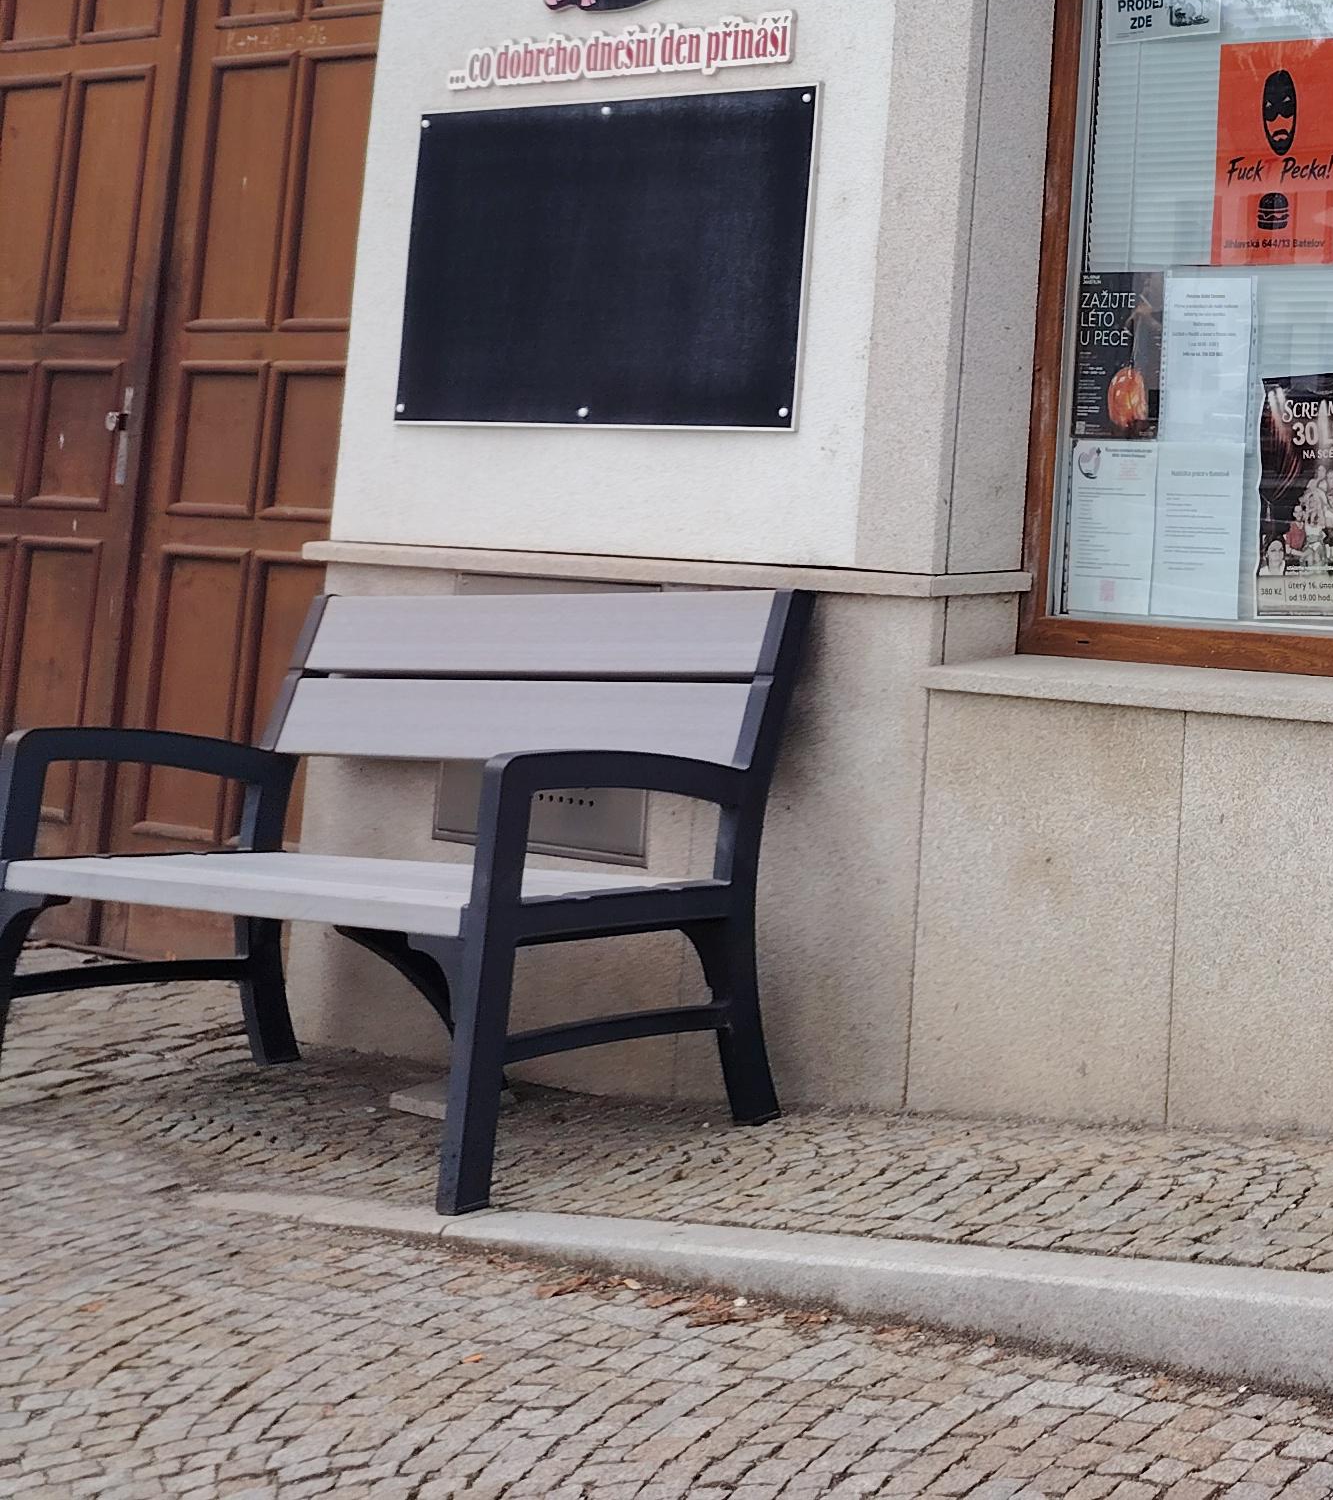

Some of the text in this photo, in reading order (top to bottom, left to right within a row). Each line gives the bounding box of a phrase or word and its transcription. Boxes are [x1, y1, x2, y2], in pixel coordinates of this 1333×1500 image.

[1129, 15, 1153, 30] ZDE
[499, 35, 581, 80] dobrého
[585, 27, 656, 74] dnešní
[660, 28, 702, 67] den
[706, 16, 791, 70] přináší
[1292, 238, 1325, 249] Batelov
[1081, 289, 1137, 309] ZAŽIJTE
[1080, 308, 1115, 328] LÉTO
[1079, 330, 1090, 346] U
[1291, 421, 1318, 446] 30
[1302, 449, 1316, 459] NA
[1289, 594, 1298, 602] od
